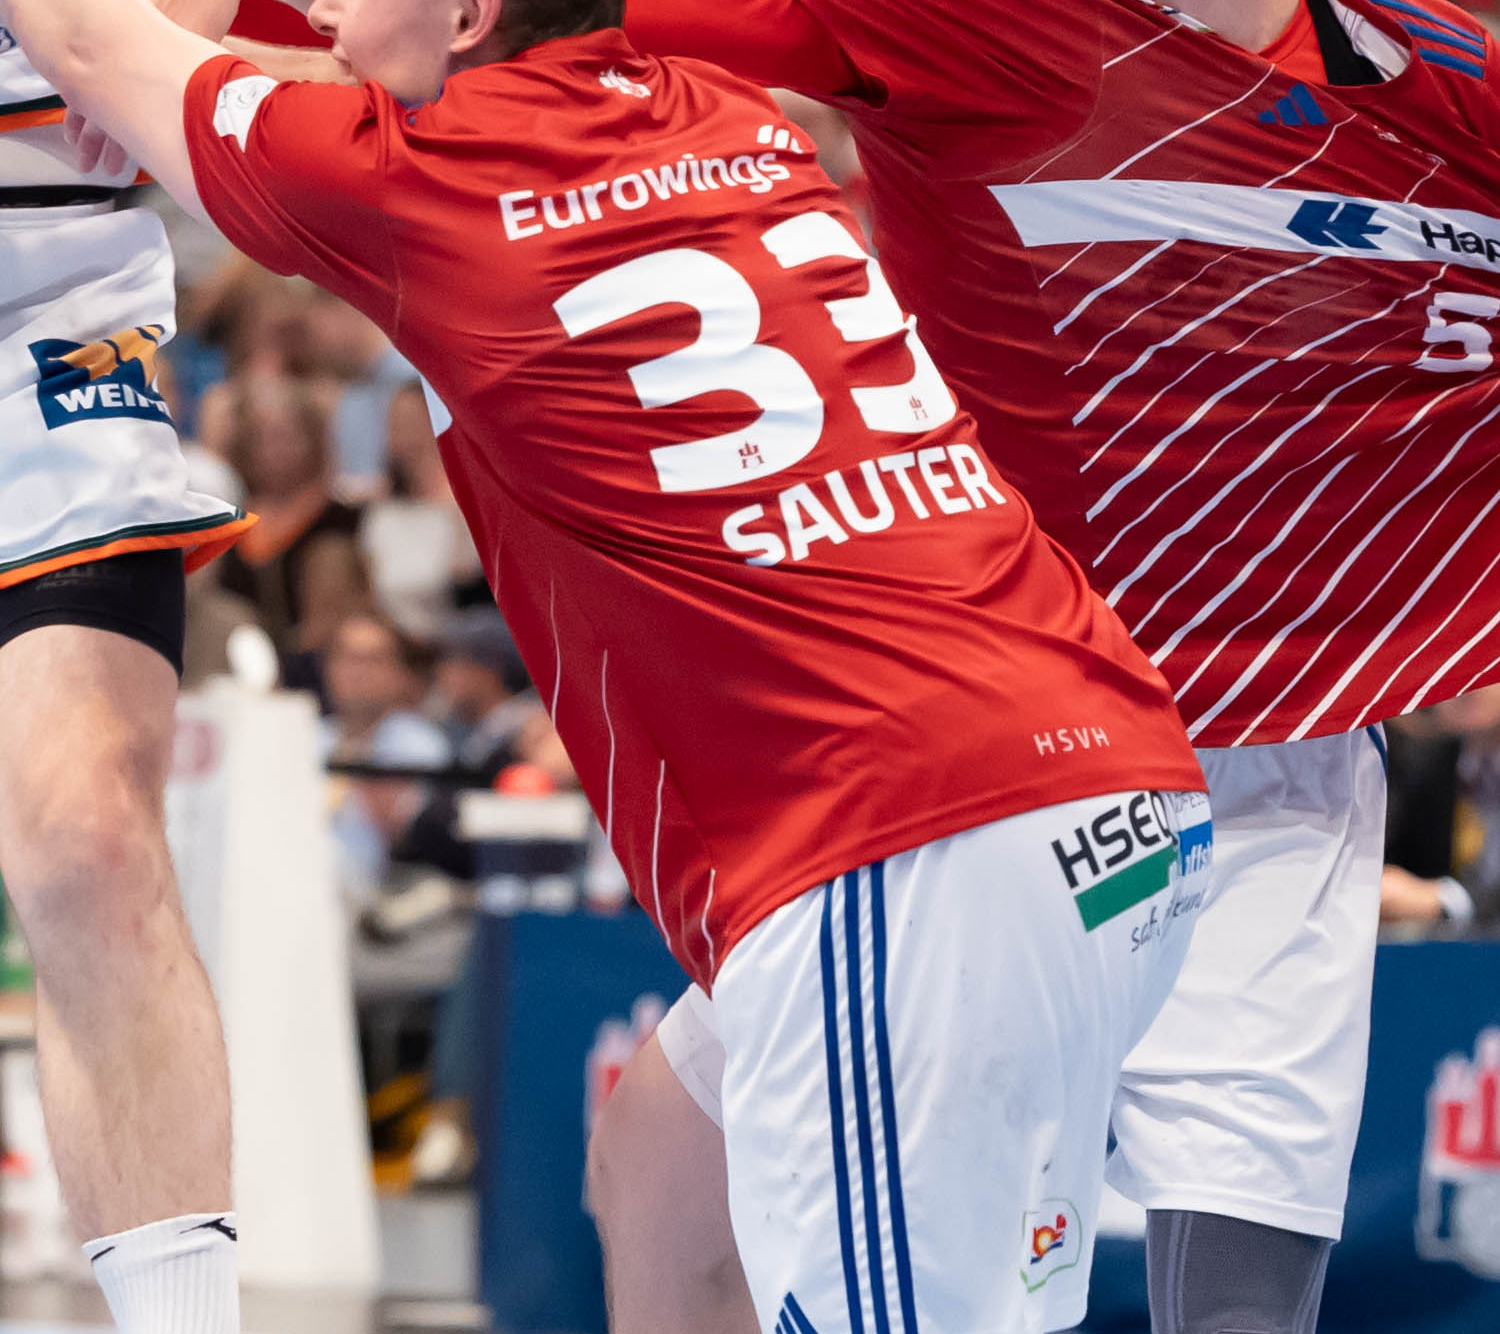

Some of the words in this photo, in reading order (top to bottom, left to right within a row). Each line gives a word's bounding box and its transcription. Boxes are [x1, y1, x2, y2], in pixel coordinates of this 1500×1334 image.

[499, 151, 790, 241] Eurowings
[552, 210, 960, 494] 33
[722, 442, 1006, 567] SAUTER
[1033, 726, 1110, 756] HSVH
